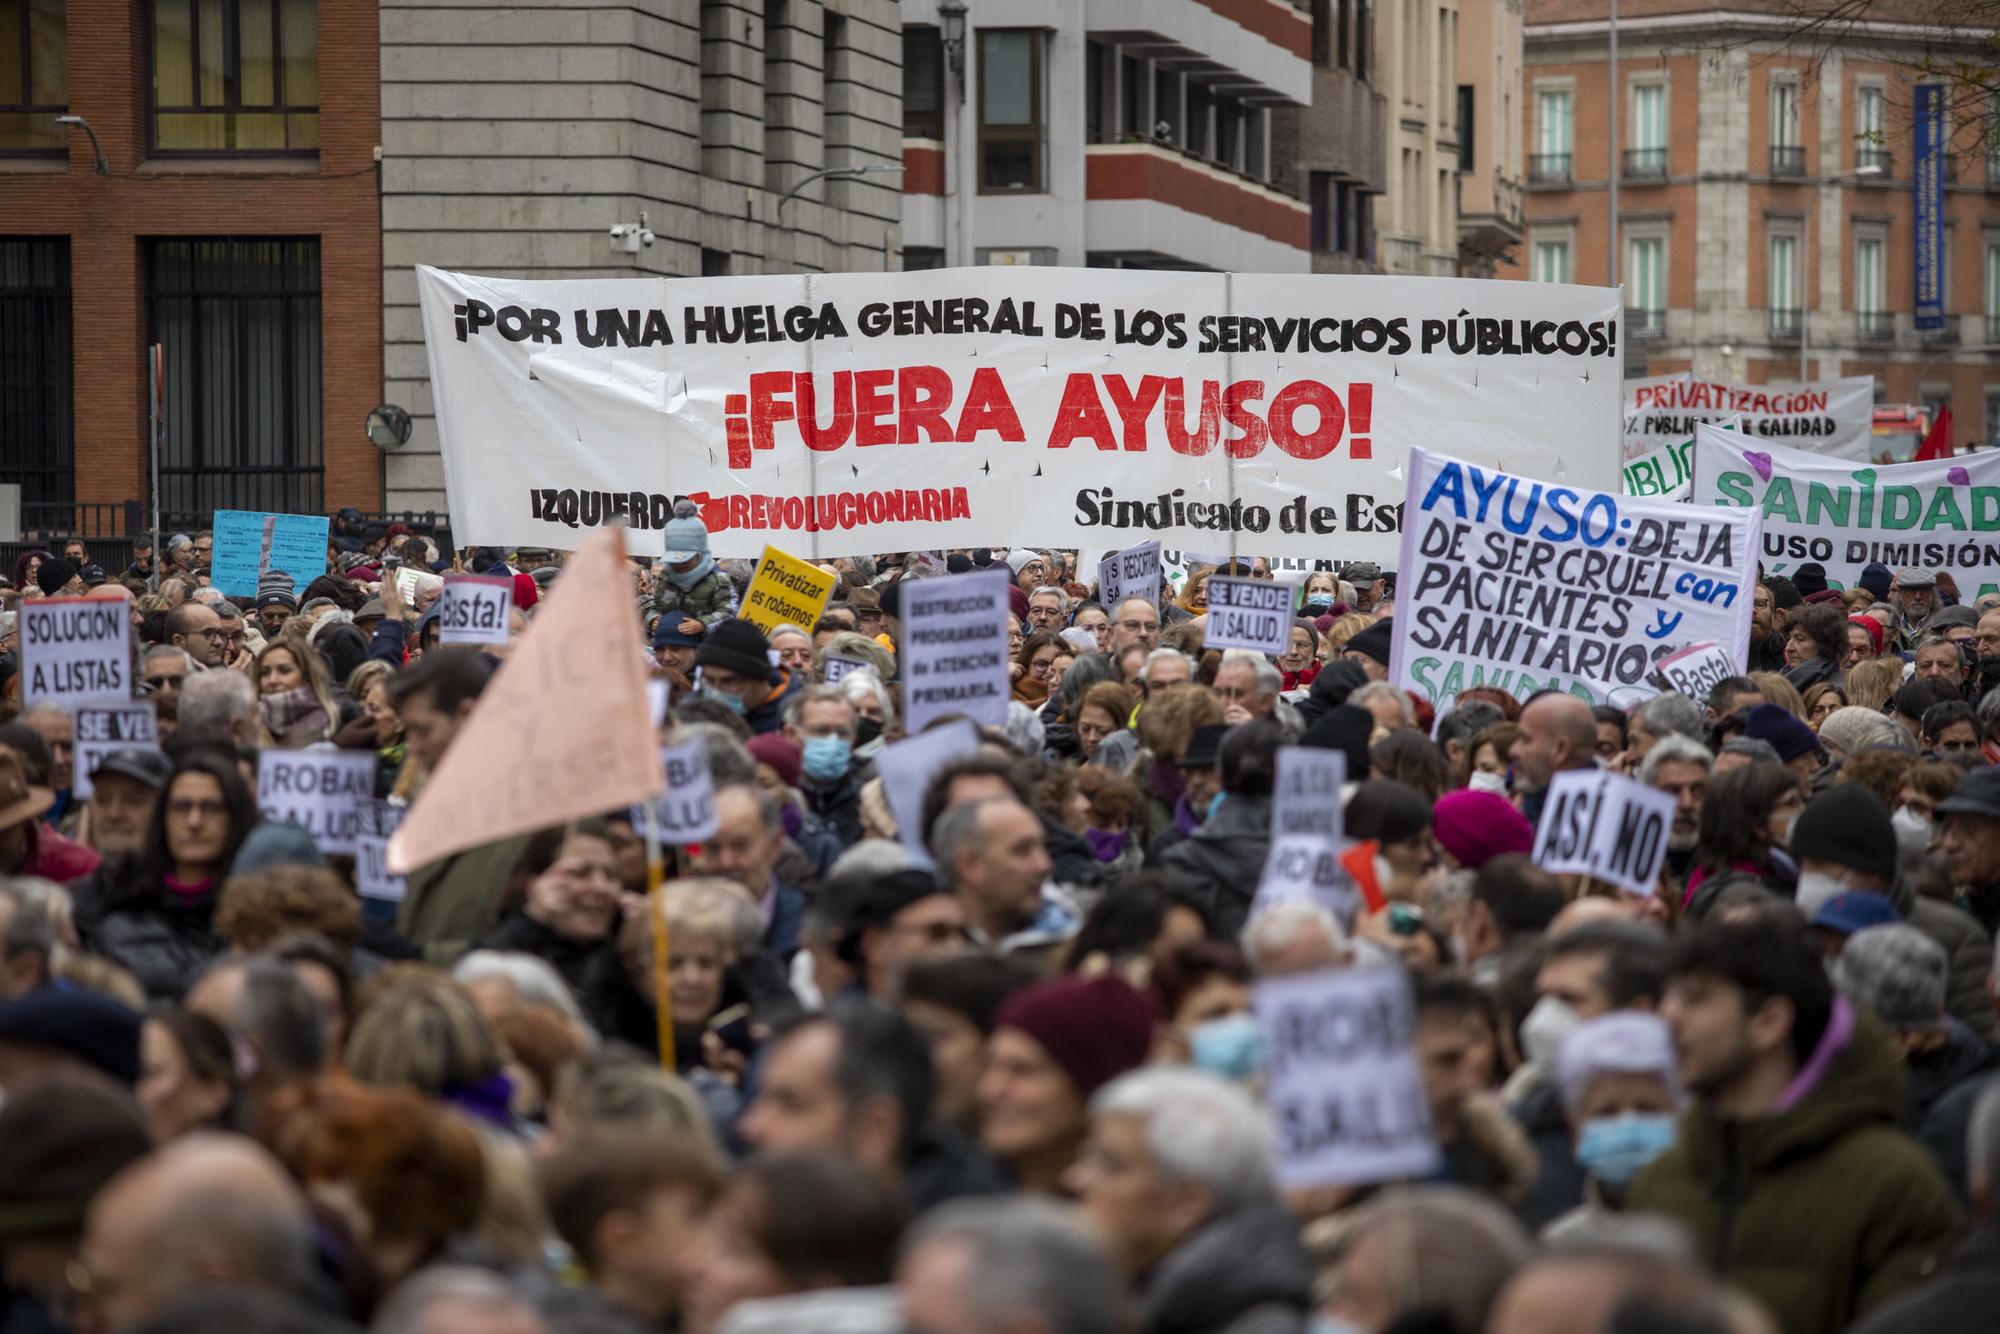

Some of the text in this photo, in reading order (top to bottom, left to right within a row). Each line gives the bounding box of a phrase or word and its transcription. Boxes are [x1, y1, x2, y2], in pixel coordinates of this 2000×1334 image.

[454, 297, 1616, 358] ¡POR UNA HUELGA GENERAL DE LOS SERVICIOS PÚBLICOS!
[725, 366, 1372, 469] ¡FUERA AYUSO!
[729, 486, 972, 532] REVOLUCIONARIA
[1075, 487, 1271, 534] Sindicato
[1279, 495, 1338, 535] de
[1420, 461, 1733, 567] AYUSO: DEJA
[1420, 517, 1480, 562] DE
[1477, 531, 1556, 579] SER
[1556, 548, 1671, 600] CRUEL
[1675, 571, 1738, 609] con
[1763, 532, 1834, 562] USO
[761, 558, 824, 599] Privatizar
[1211, 582, 1289, 611] SE VENDE
[1413, 562, 1683, 639] PACIENTES y
[28, 601, 120, 643] SOLUCIÓN
[751, 589, 814, 628] es robarnos
[1211, 611, 1281, 644] TU SALUD.
[32, 660, 121, 695] A LISTAS
[79, 711, 110, 740] SE
[1609, 800, 1663, 884] NO
